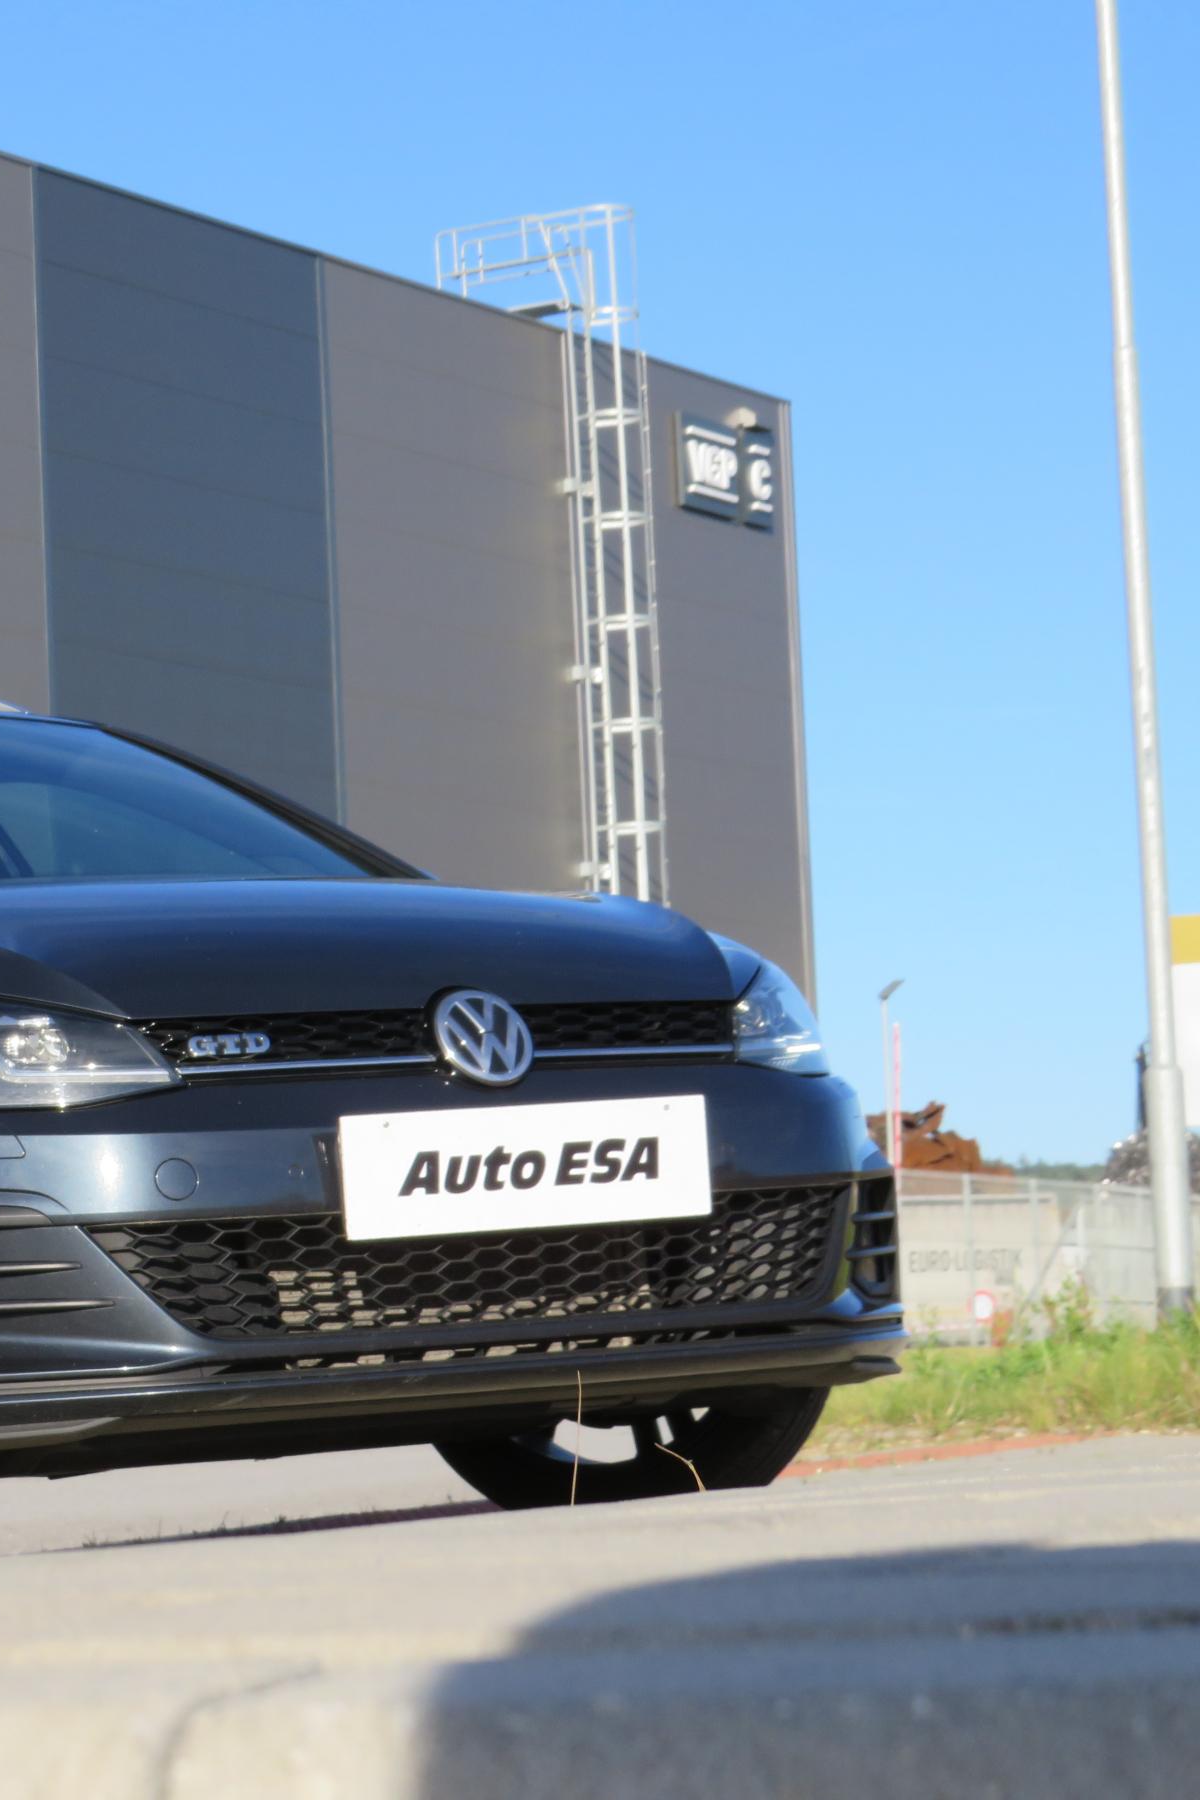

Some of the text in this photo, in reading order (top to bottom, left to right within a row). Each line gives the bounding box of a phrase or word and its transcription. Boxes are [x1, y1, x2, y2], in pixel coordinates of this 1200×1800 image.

[188, 1032, 272, 1058] GTD
[399, 1137, 660, 1197] Auto ESA
